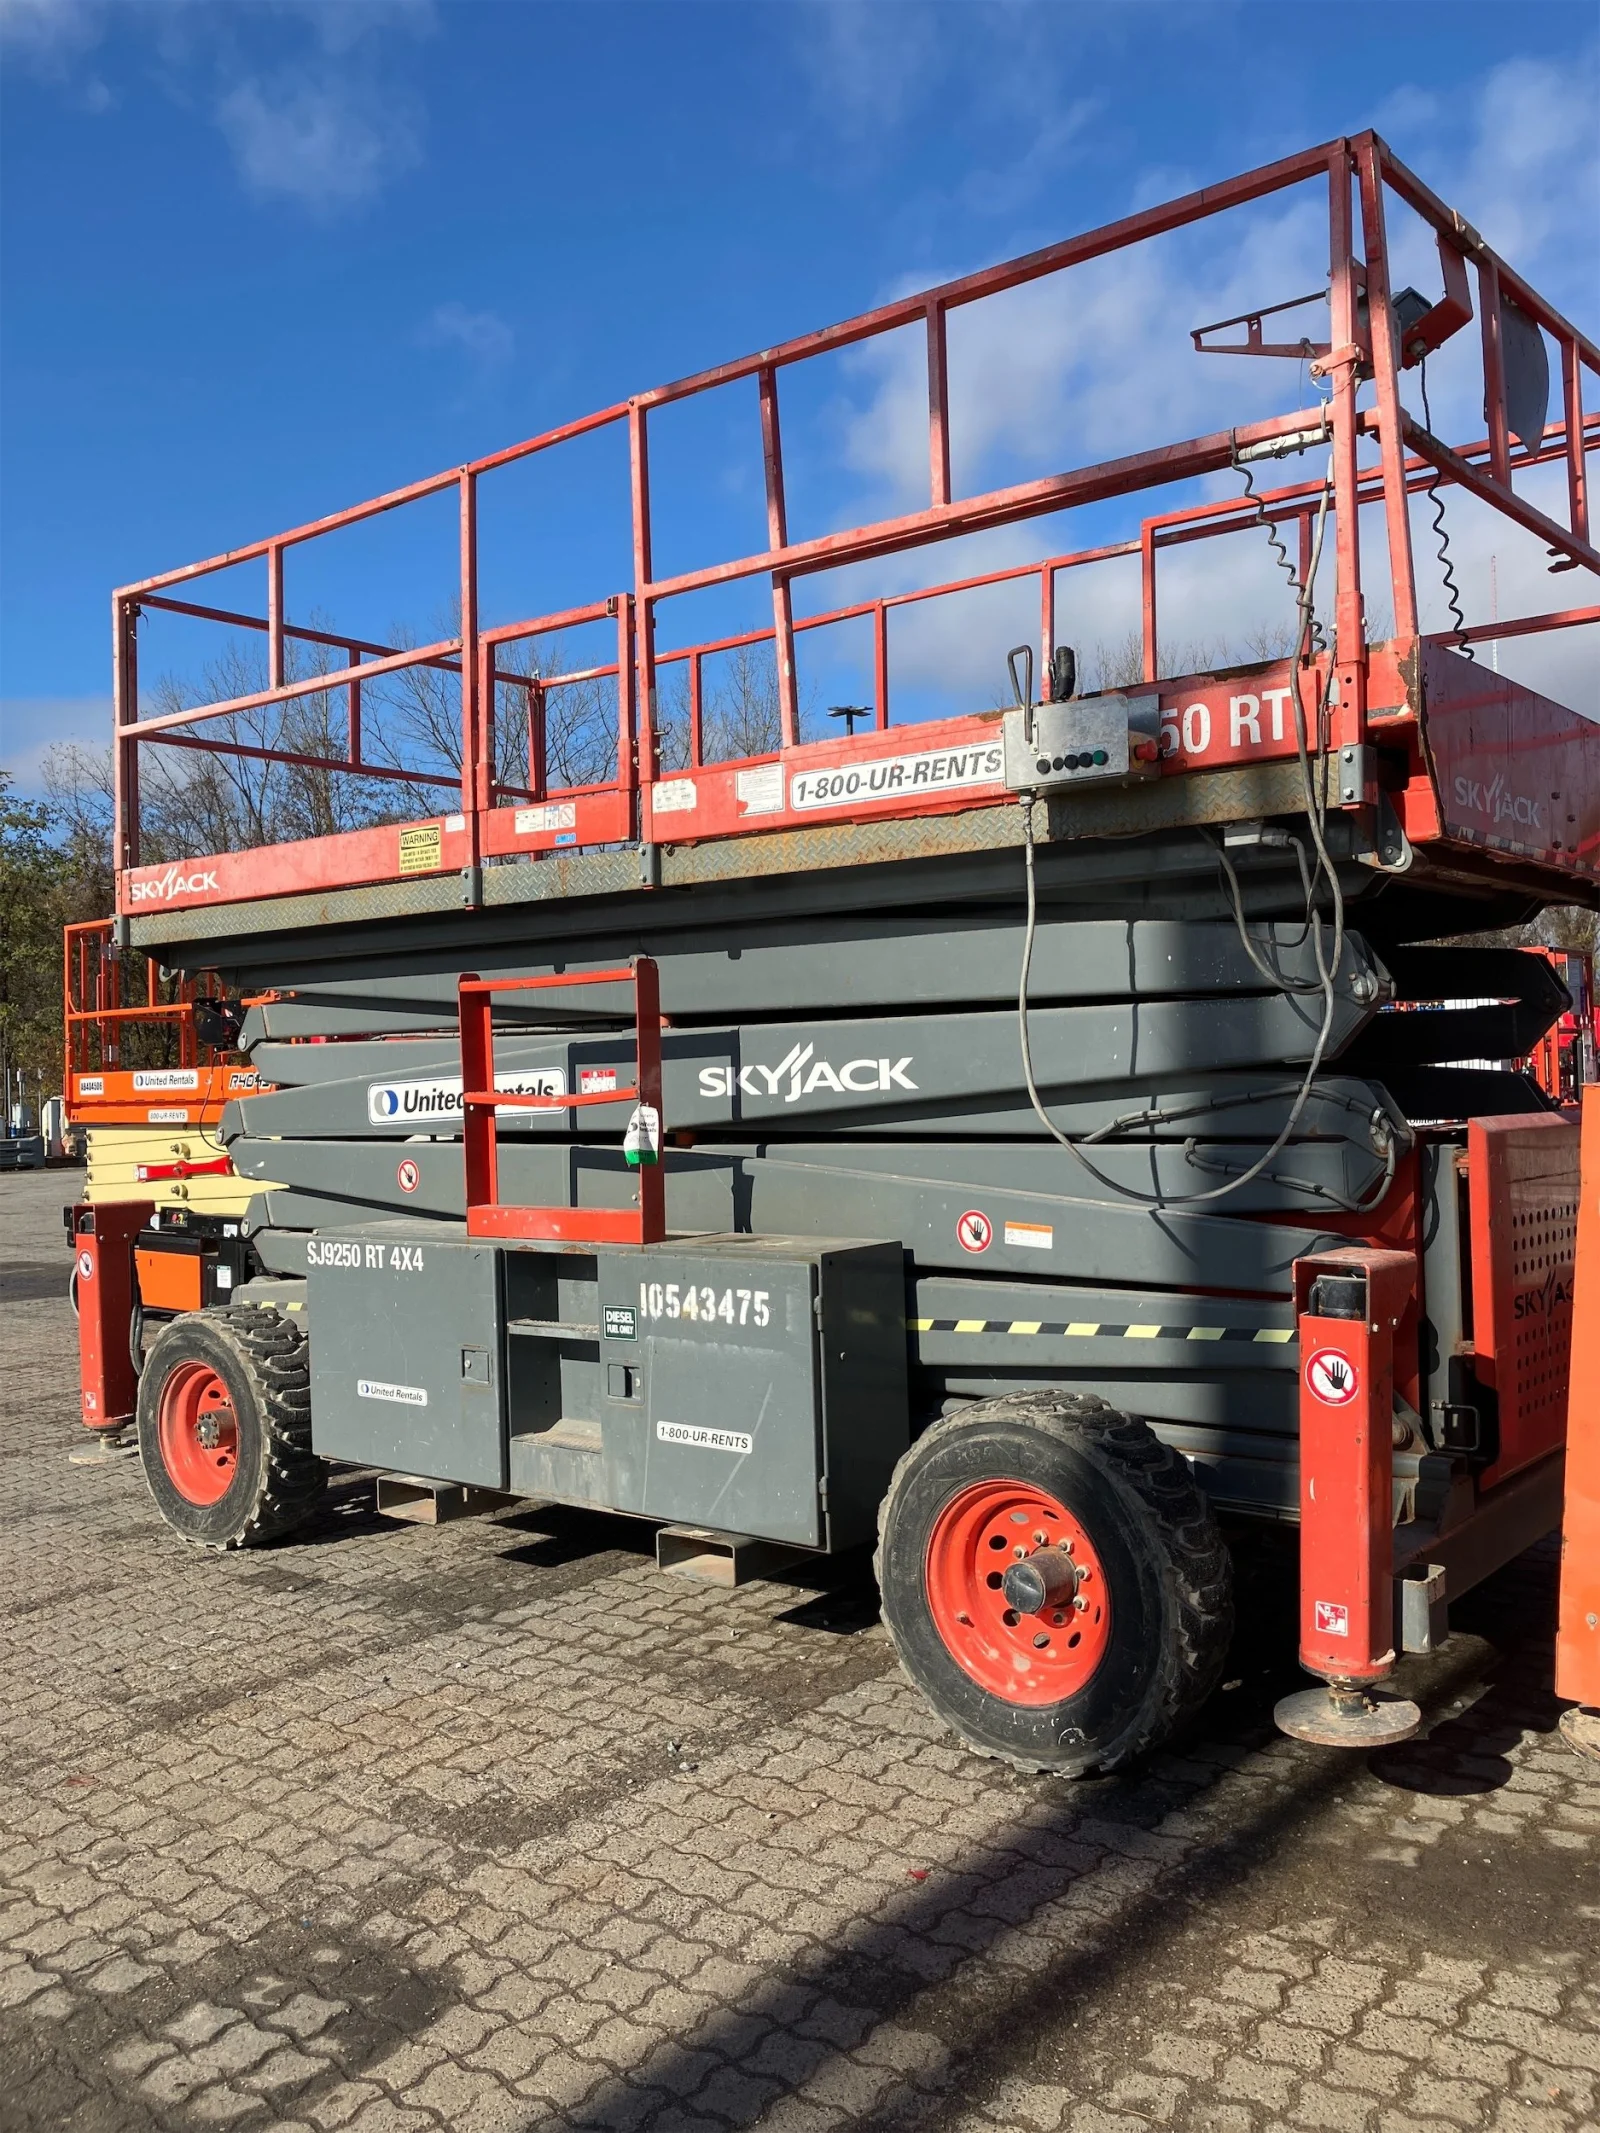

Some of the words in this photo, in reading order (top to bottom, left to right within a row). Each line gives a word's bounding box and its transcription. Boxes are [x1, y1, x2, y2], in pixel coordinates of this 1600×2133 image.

[1229, 687, 1292, 747] RT
[797, 748, 1003, 802] 1-800-UR-RENTS
[1455, 771, 1541, 829] SKYJACK
[402, 831, 438, 846] WARNING
[131, 866, 220, 901] SKYJACK
[145, 1075, 168, 1086] United
[169, 1074, 194, 1085] Rentals
[229, 1073, 271, 1088] R40
[698, 1041, 919, 1103] SKYJACK
[307, 1241, 361, 1268] SJ9250
[365, 1244, 386, 1269] RT
[389, 1246, 424, 1271] 4X4
[640, 1283, 770, 1327] 10543475
[1514, 1269, 1574, 1319] SKYJAC
[606, 1310, 635, 1324] DIESEL
[607, 1323, 620, 1334] FUEL
[619, 1324, 634, 1335] ONLY
[371, 1384, 395, 1397] United
[396, 1389, 423, 1401] Rentals
[660, 1426, 749, 1449] 1-800-UR-RENTS
